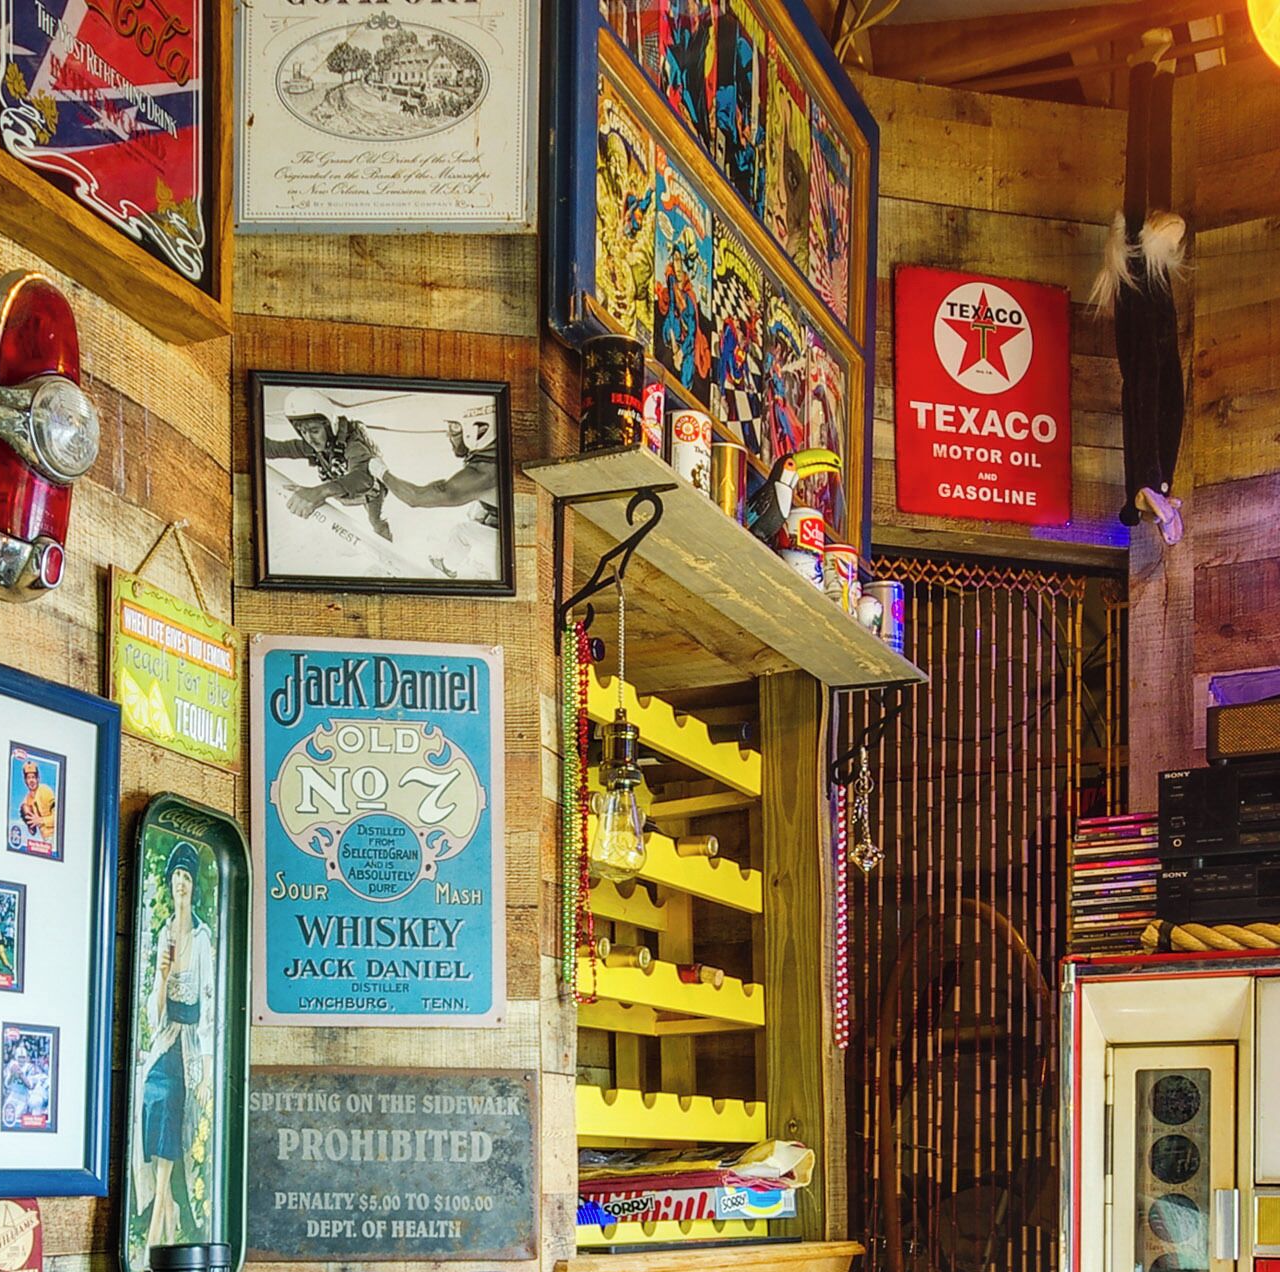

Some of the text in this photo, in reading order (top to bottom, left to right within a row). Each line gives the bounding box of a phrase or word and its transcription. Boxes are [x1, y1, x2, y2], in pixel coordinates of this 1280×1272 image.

[34, 2, 179, 139] THE MOST REFRESHING DRINK
[946, 302, 1022, 325] TEXACO
[910, 400, 1057, 443] TEXACO
[932, 443, 1042, 468] MOTOR OIL
[977, 472, 998, 482] AND
[937, 483, 1037, 506] GASOLINE
[123, 605, 148, 639] WHEN
[148, 616, 165, 645] LIFE
[165, 623, 187, 655] GIVES
[187, 633, 203, 663] YOU
[124, 643, 231, 710] reach for the
[373, 655, 480, 714] Daniel
[175, 696, 229, 752] TEQUILA!
[336, 726, 421, 754] OLD
[1164, 771, 1191, 780] SONY
[398, 767, 462, 825] 7
[356, 824, 406, 838] DISTILLED
[368, 838, 396, 847] FROM
[342, 846, 419, 861] SELECTED GRAIN
[364, 861, 394, 870] AND IS
[270, 871, 330, 902] SOUR
[347, 868, 416, 883] ABSOLUTELY
[434, 884, 484, 906] MASH
[295, 914, 465, 949] WHISKEY
[283, 957, 474, 981] JACK DANIEL
[351, 981, 411, 994] DISTILLER
[298, 996, 471, 1012] LYNCHBURG, TENN.
[249, 1091, 521, 1116] SPITTING ON THE SIDEWALK
[277, 1127, 494, 1164] PROHIBITED
[274, 1191, 495, 1213] PENALTY $5.00 TO $100.00
[604, 1194, 657, 1218] SORRY!
[306, 1219, 462, 1239] DEPT. OF HEALTH
